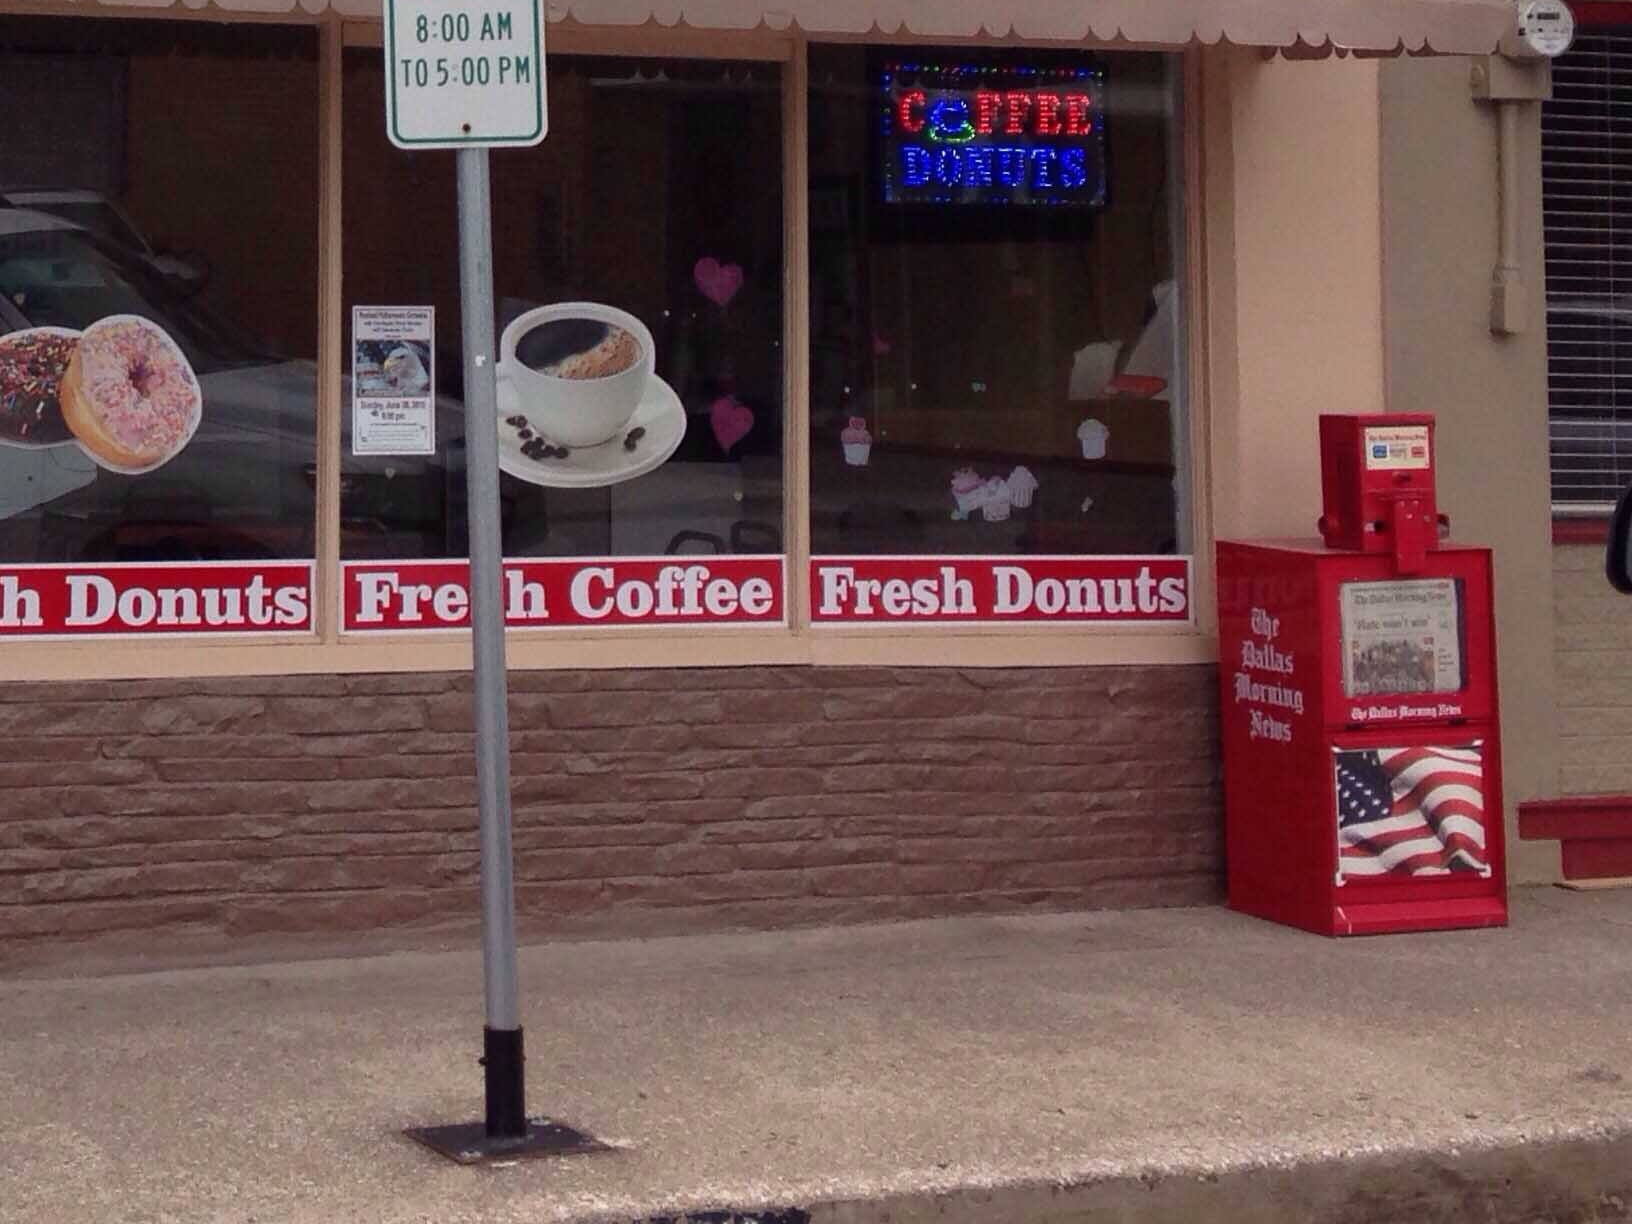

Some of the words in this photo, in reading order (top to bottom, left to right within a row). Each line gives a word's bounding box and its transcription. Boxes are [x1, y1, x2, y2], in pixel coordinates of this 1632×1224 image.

[416, 13, 469, 43] 8:00
[480, 12, 512, 40] AM
[401, 59, 428, 87] TO
[437, 57, 490, 87] 5:00
[499, 56, 531, 85] PM
[902, 147, 1087, 187] DONUTS
[65, 575, 308, 627] Donuts
[355, 569, 550, 623] Freh
[570, 565, 773, 619] Coffee
[818, 565, 976, 616] Fresh
[993, 565, 1187, 616] Donuts
[1251, 607, 1280, 640] The
[1242, 640, 1294, 673] Dallas
[1234, 671, 1304, 715] Morning
[1249, 709, 1292, 742] News
[1352, 707, 1367, 721] The
[1368, 706, 1398, 719] Dallas
[1399, 705, 1437, 719] Morning
[1438, 704, 1463, 716] News
